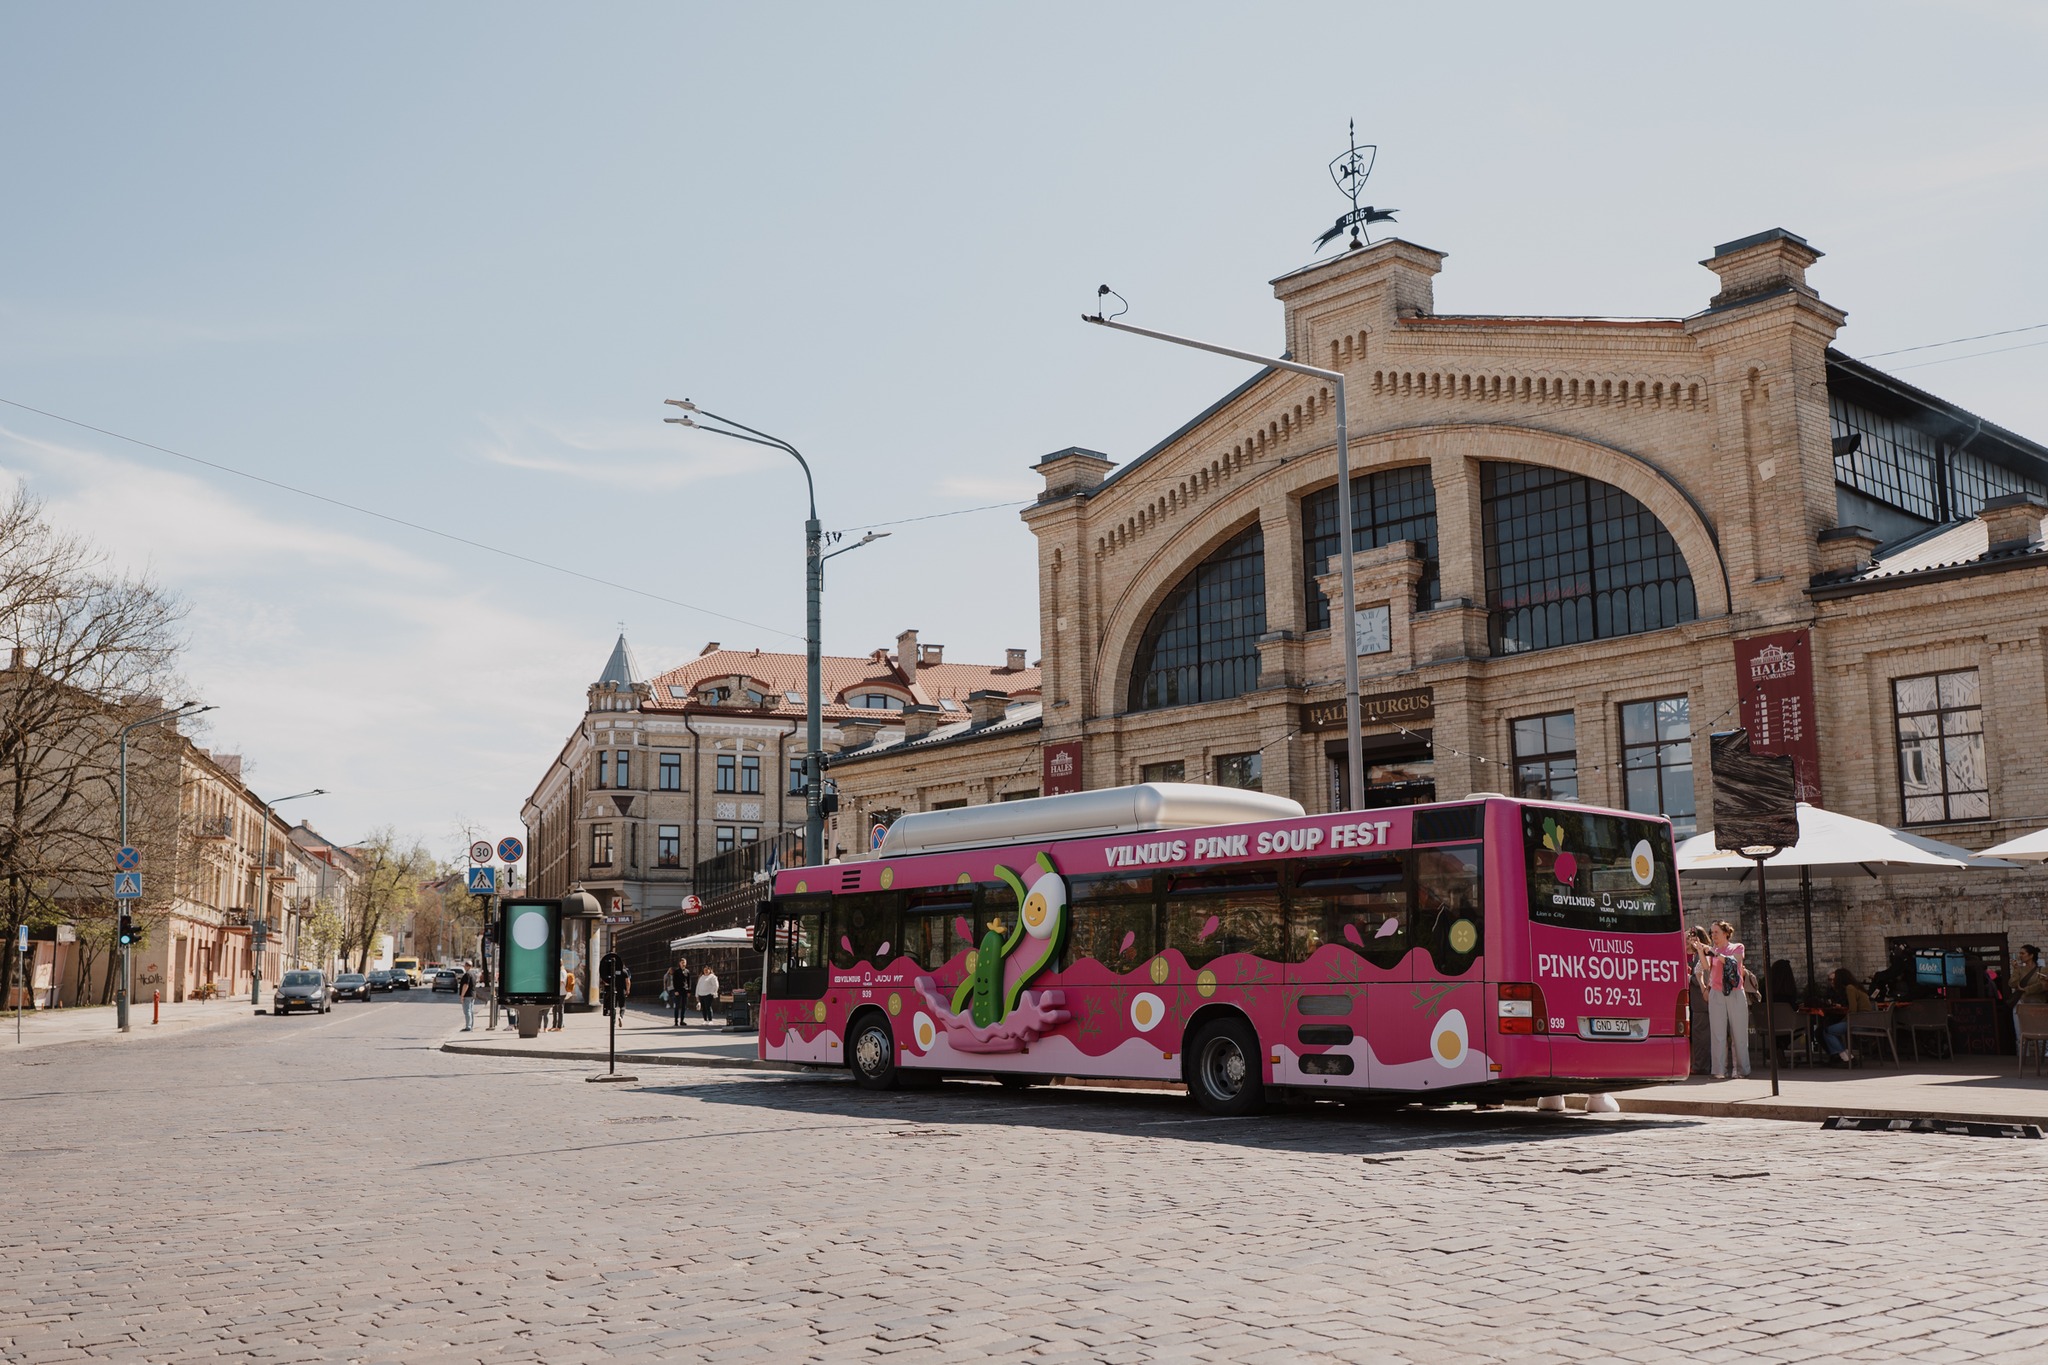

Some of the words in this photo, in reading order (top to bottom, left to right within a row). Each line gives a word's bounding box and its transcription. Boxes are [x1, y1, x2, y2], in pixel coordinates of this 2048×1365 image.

[1310, 705, 1348, 722] HAL
[1365, 694, 1430, 716] TURGUS
[1105, 840, 1187, 867] VILNIUS
[1194, 834, 1249, 859] PINK
[1257, 827, 1324, 854] SOUP
[1331, 821, 1391, 848] FEST
[476, 847, 489, 857] 30
[1599, 916, 1618, 924] MAN
[1588, 938, 1634, 955] VILNIUS
[1538, 953, 1587, 979] PINK
[1588, 956, 1639, 980] SOUP
[1641, 959, 1679, 982] FEST
[1919, 962, 1938, 972] Wolt
[862, 990, 872, 998] 939
[1584, 986, 1602, 1005] 05
[1605, 987, 1643, 1006] 29-31
[1550, 1017, 1565, 1029] 939
[1615, 1021, 1628, 1031] 527
